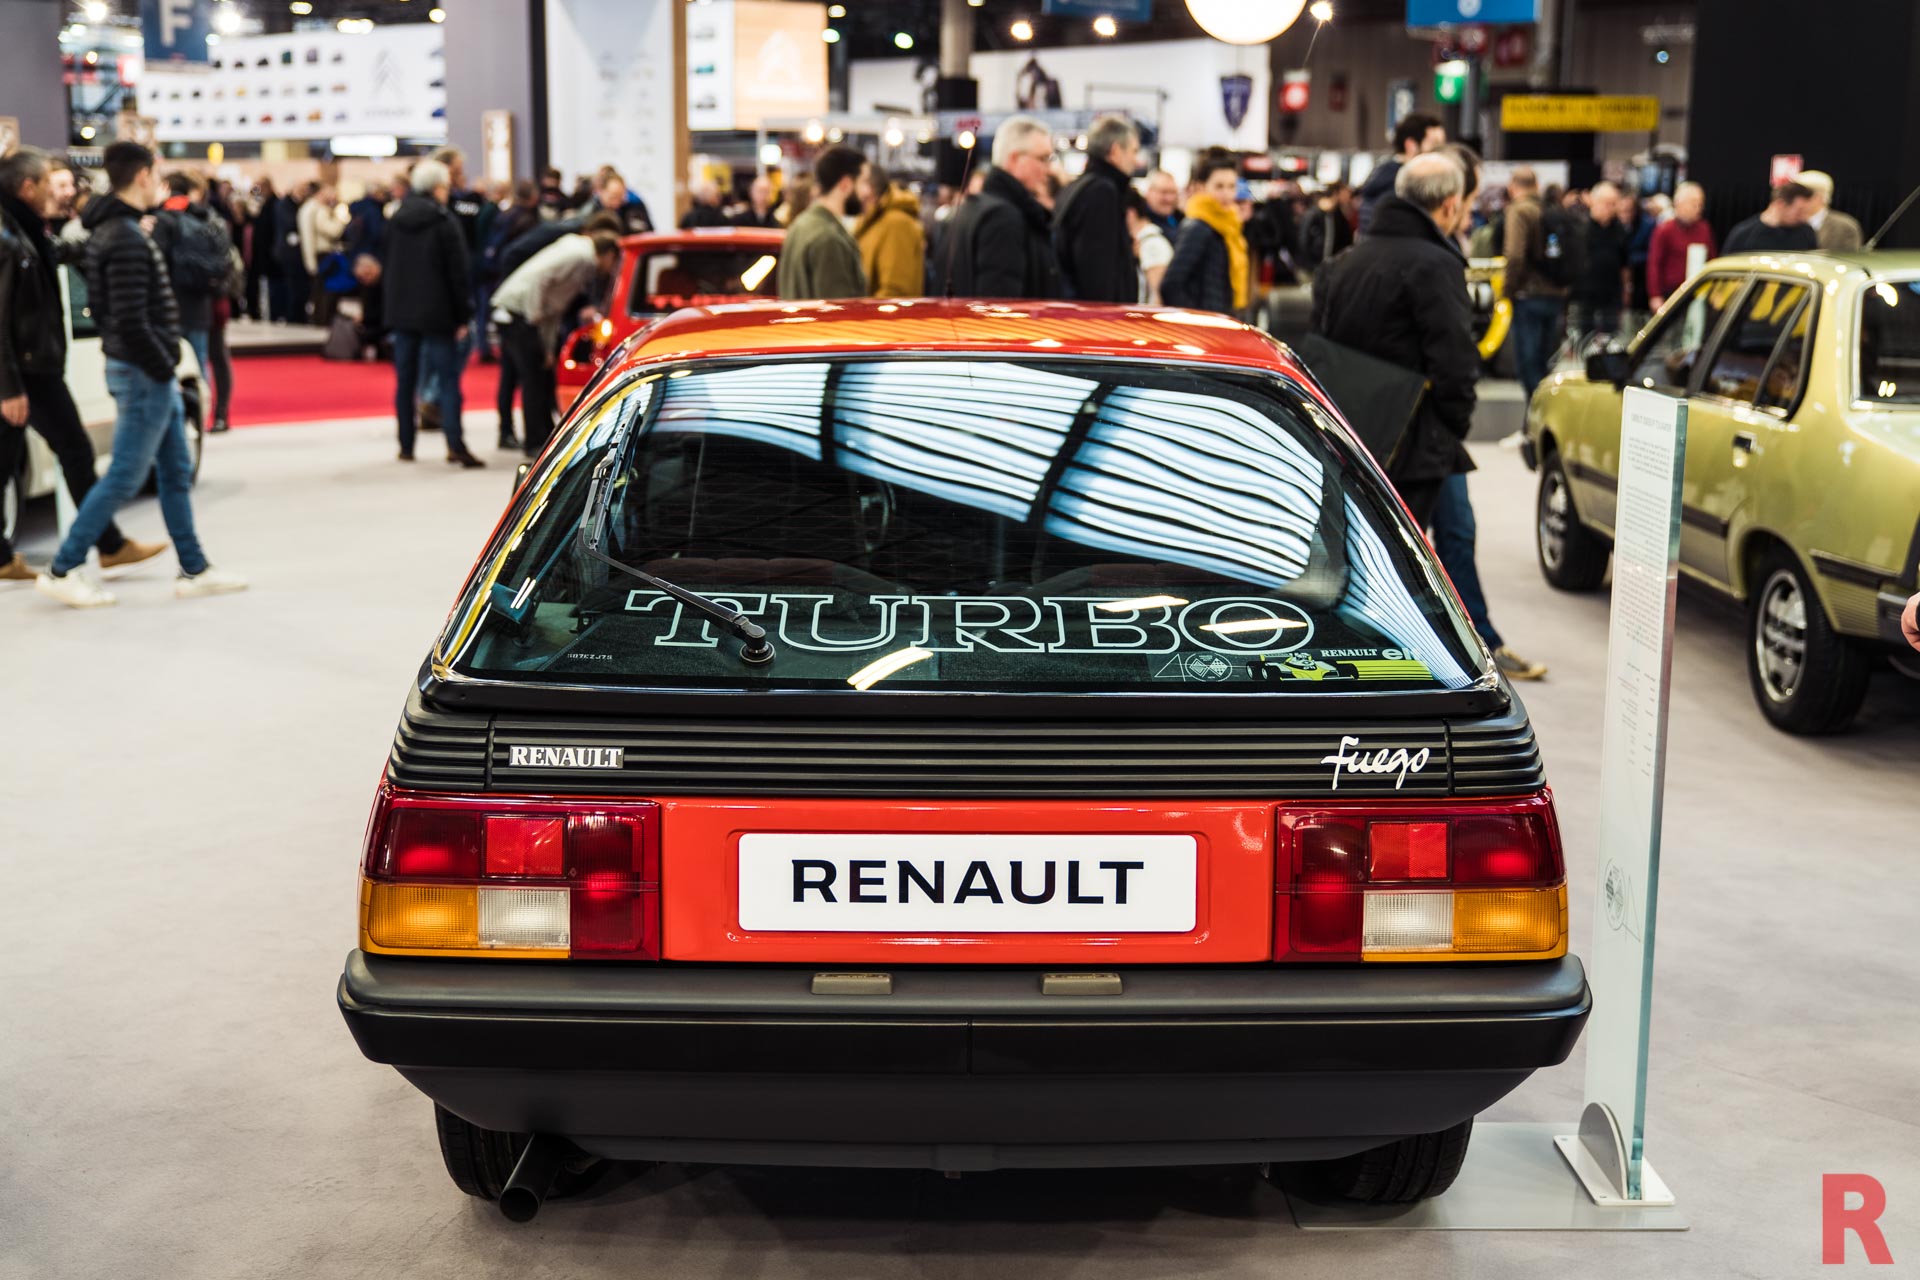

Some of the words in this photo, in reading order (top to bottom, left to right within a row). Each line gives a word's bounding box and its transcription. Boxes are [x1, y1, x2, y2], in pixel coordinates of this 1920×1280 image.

[160, 0, 194, 48] F
[624, 589, 1315, 656] TURBO
[1320, 648, 1378, 657] RENAULT
[510, 746, 622, 768] RENAULT
[791, 859, 1145, 905] RENAULT
